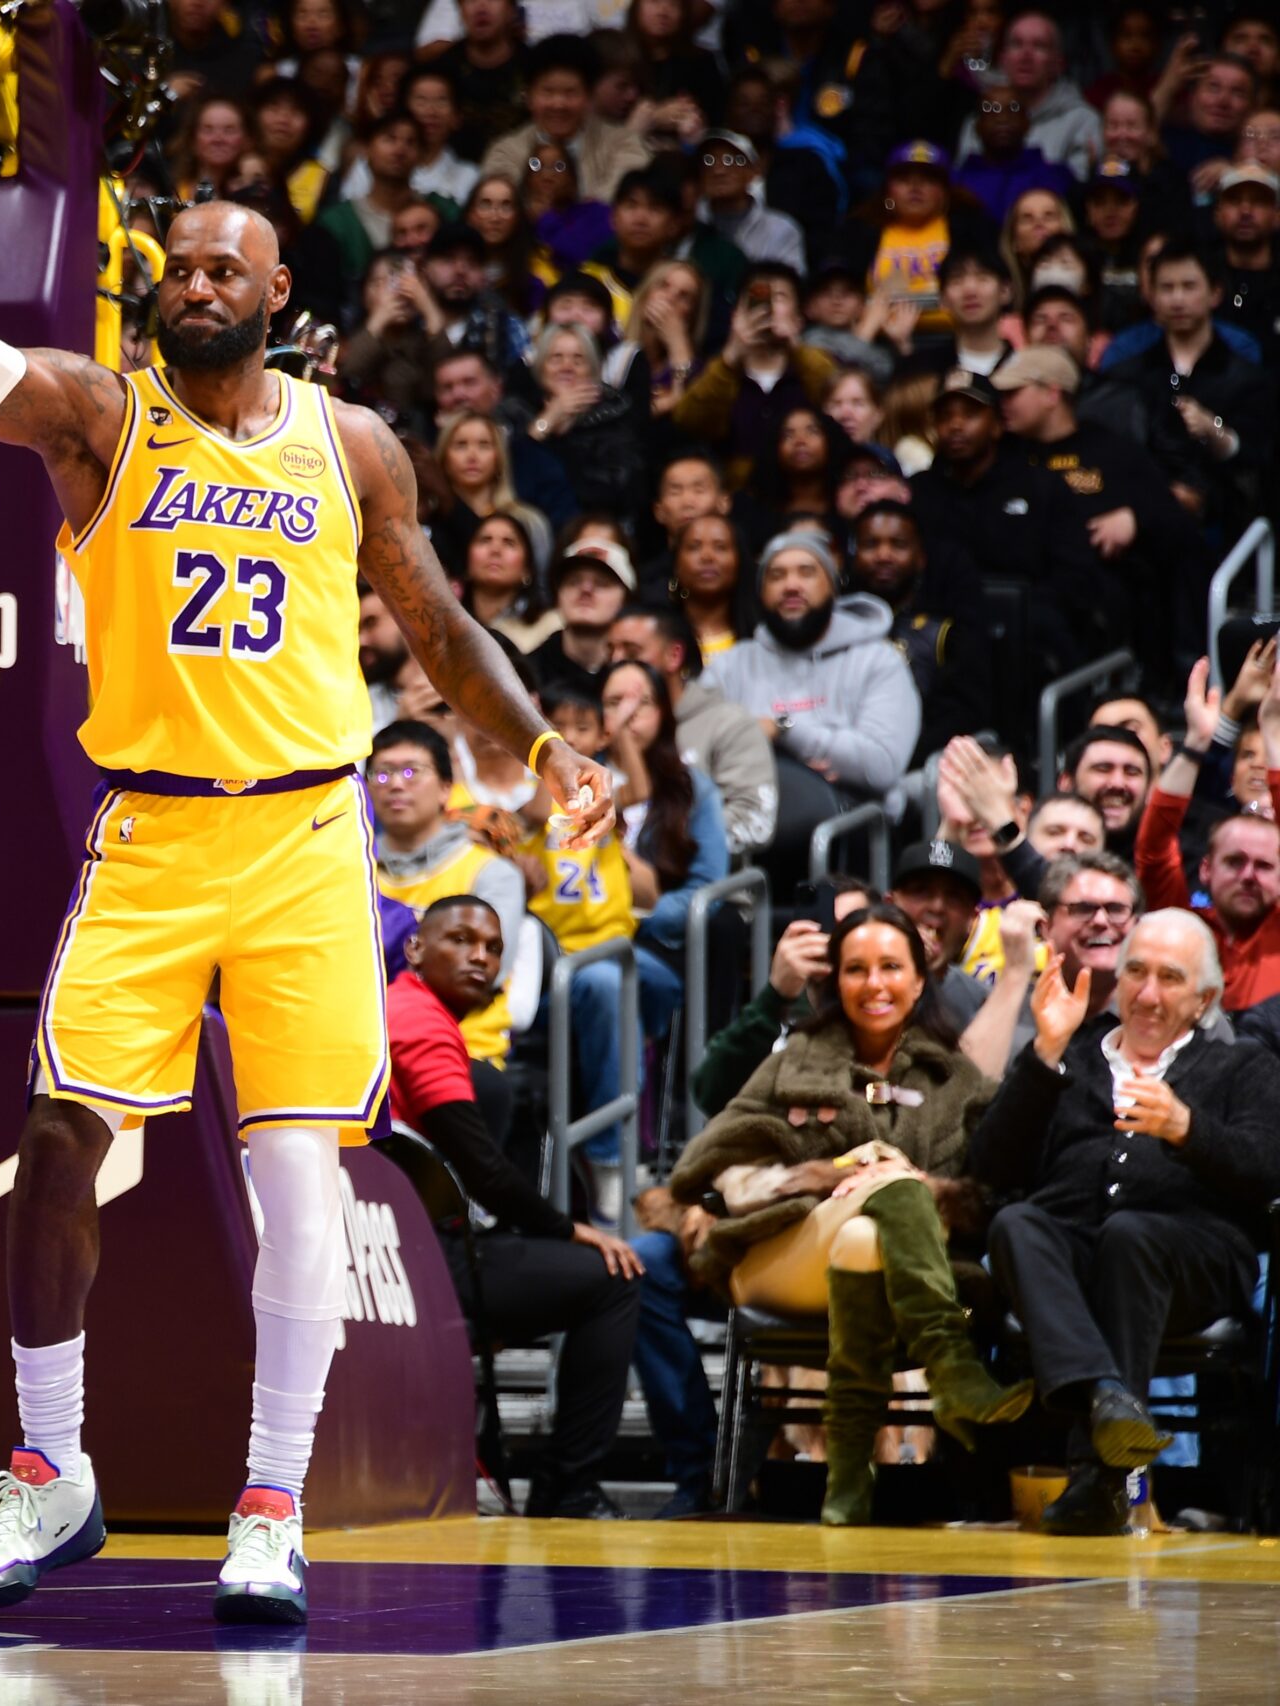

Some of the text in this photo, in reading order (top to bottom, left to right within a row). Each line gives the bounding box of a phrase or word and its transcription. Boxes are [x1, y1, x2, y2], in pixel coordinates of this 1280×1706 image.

[283, 451, 323, 469] bibigo
[127, 465, 320, 545] LAKERS
[167, 548, 289, 662] 23
[553, 859, 608, 904] 24
